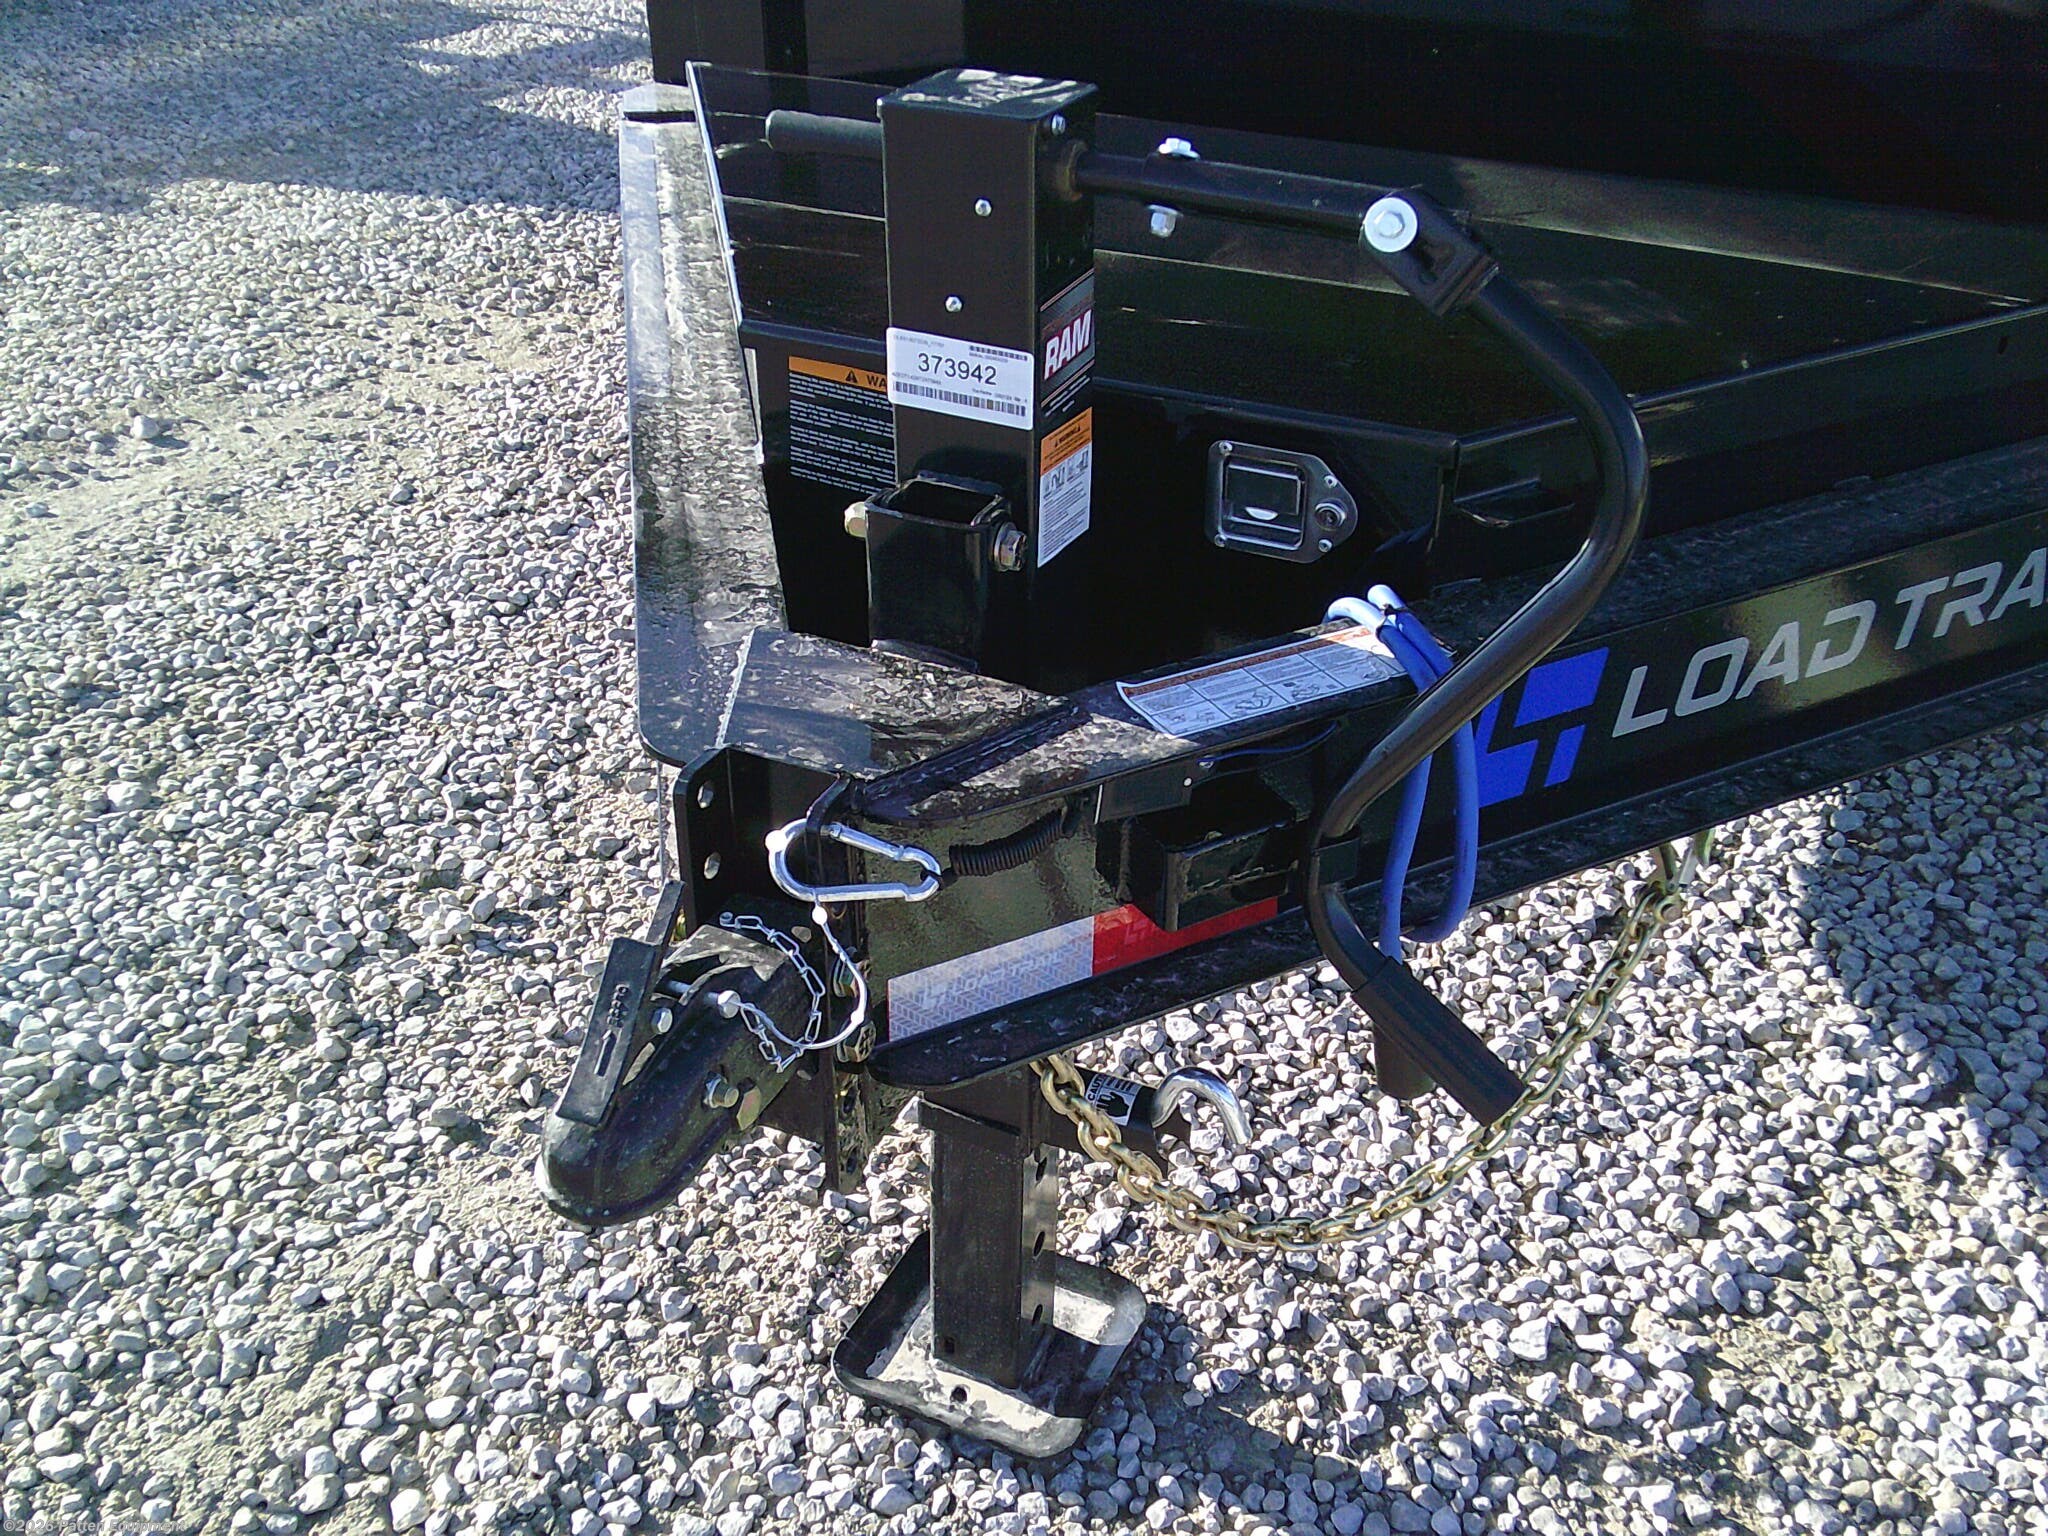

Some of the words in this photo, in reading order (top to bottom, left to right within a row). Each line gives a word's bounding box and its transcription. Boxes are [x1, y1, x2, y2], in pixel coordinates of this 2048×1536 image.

[917, 352, 998, 386] 373942
[1044, 309, 1092, 380] RAM
[1611, 598, 1877, 738] LOAD
[1893, 547, 2048, 651] TRA
